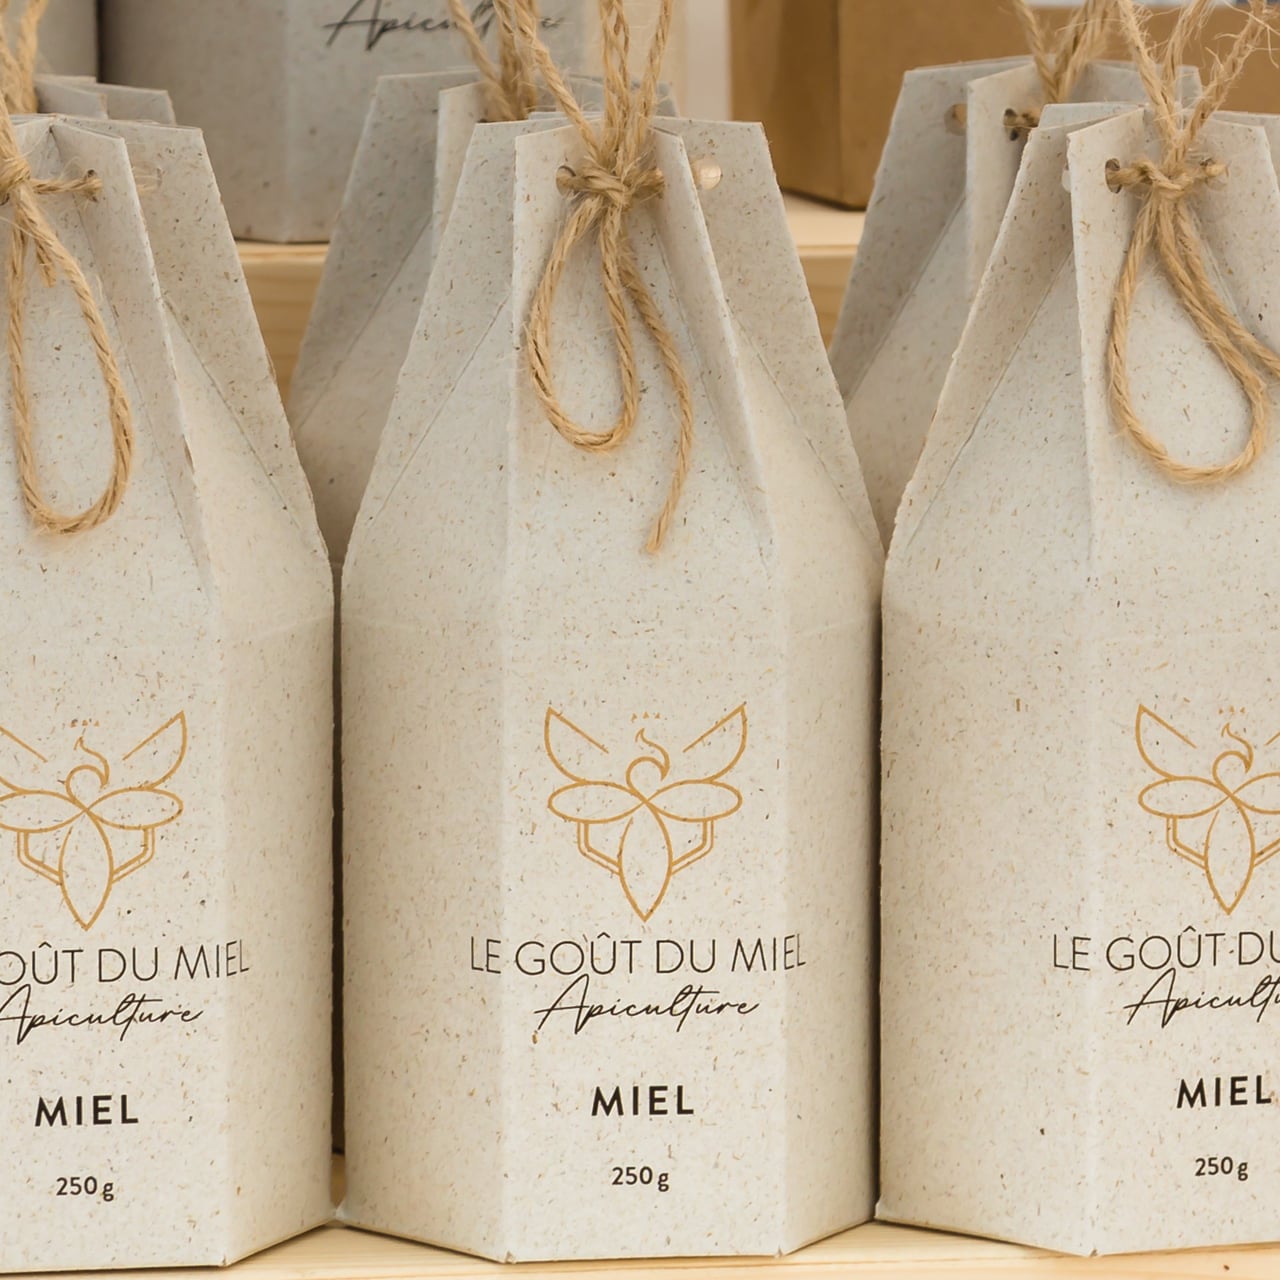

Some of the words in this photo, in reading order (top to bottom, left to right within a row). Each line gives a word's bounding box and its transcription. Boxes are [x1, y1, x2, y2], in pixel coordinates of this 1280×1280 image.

[98, 946, 159, 983] DU
[174, 939, 250, 980] MIEL
[470, 935, 502, 974] LE
[515, 931, 642, 976] GOÛT
[656, 938, 716, 974] DU
[731, 933, 806, 973] MIEL
[1053, 933, 1091, 971] LE
[1106, 925, 1226, 971] GOÛT
[533, 973, 759, 1035] Apiculture
[34, 1094, 139, 1127] MIEL
[590, 1085, 694, 1117] MIEL
[1176, 1075, 1272, 1109] MIEL
